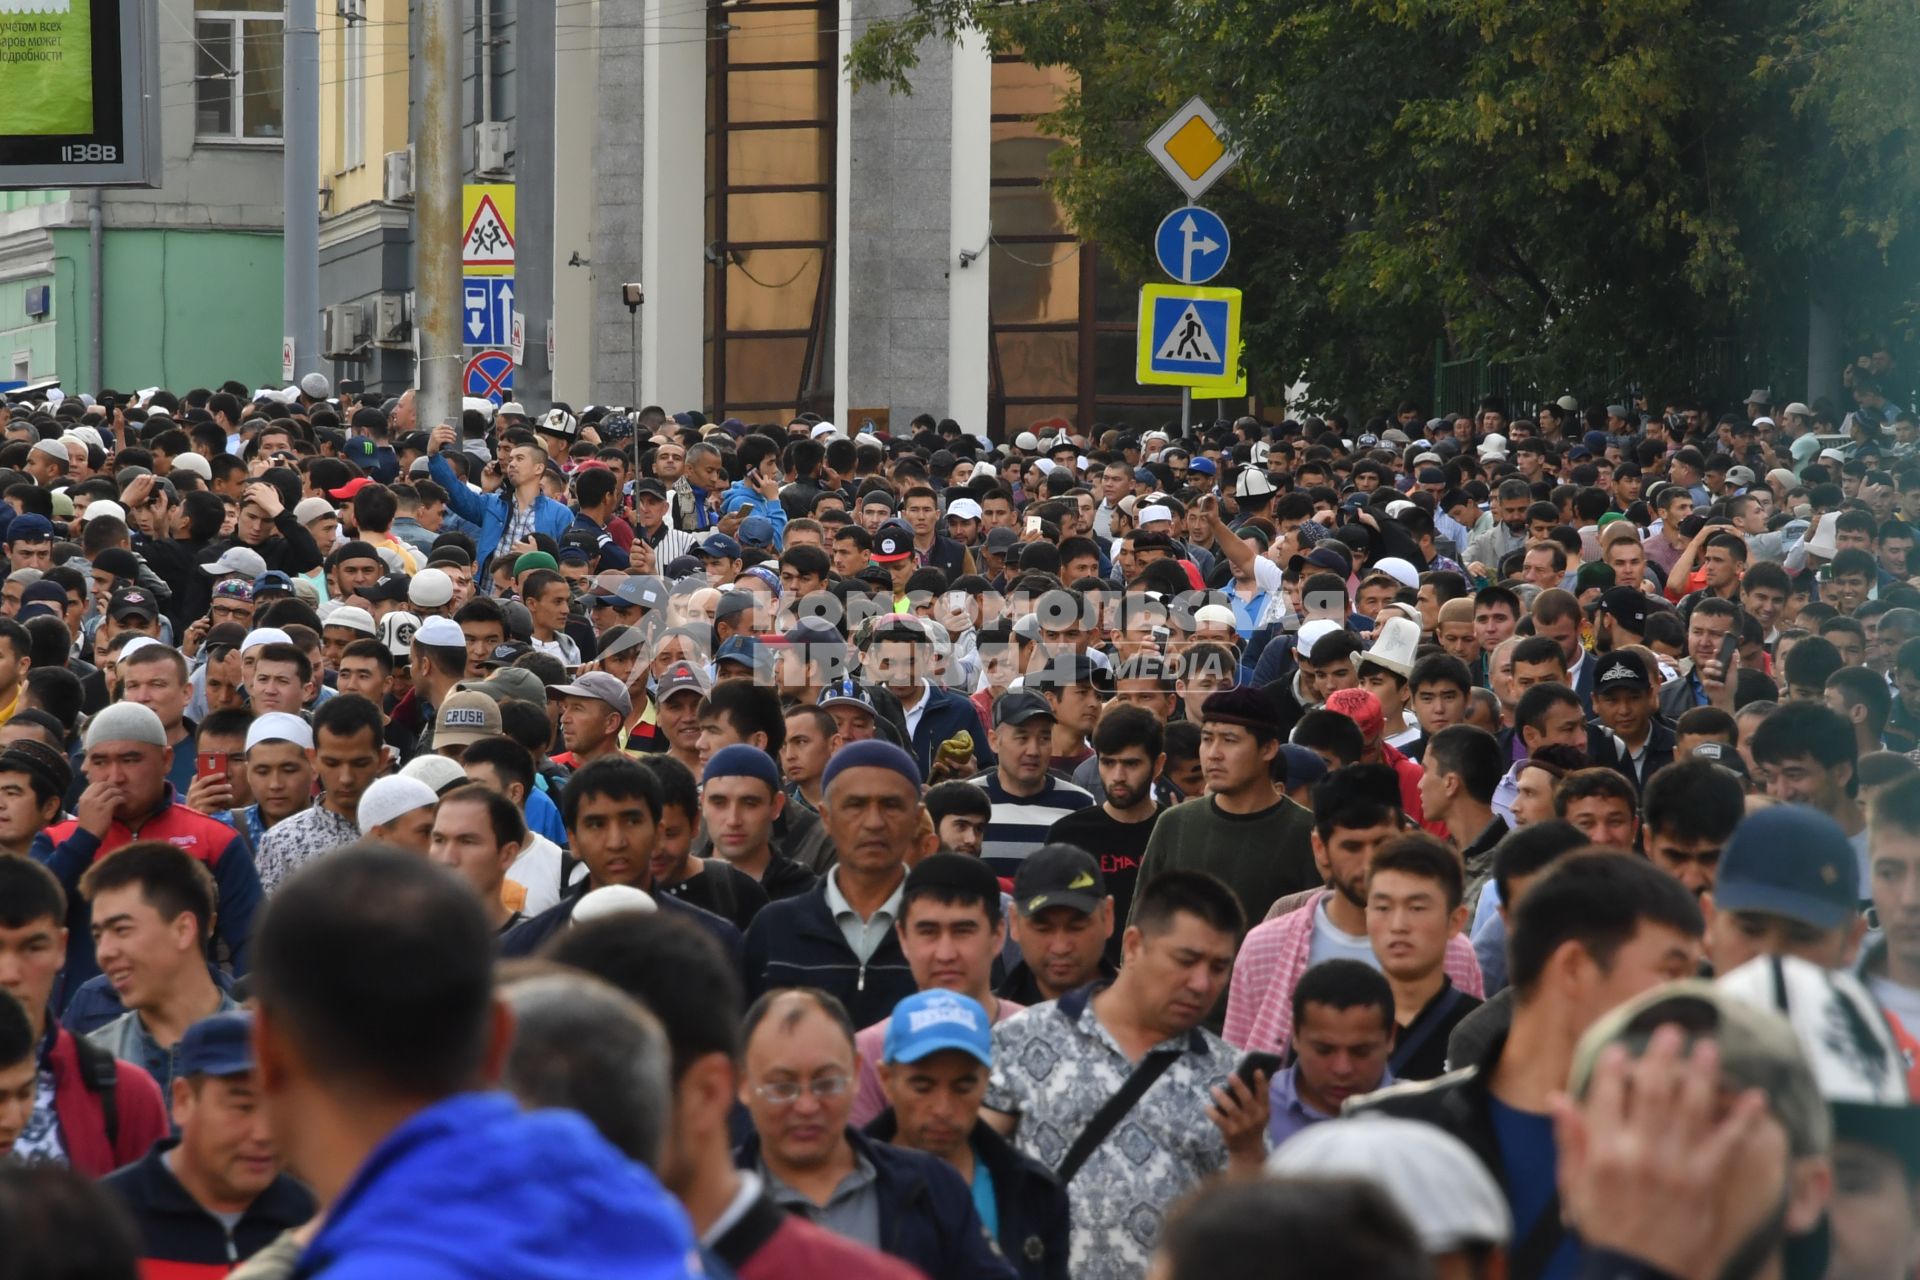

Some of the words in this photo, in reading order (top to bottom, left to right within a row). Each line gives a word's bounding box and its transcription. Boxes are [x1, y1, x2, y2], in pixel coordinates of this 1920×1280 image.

[40, 22, 62, 32] всех
[0, 37, 26, 49] аров
[28, 36, 61, 47] может
[0, 48, 63, 64] одробности
[446, 710, 483, 723] CRUSH
